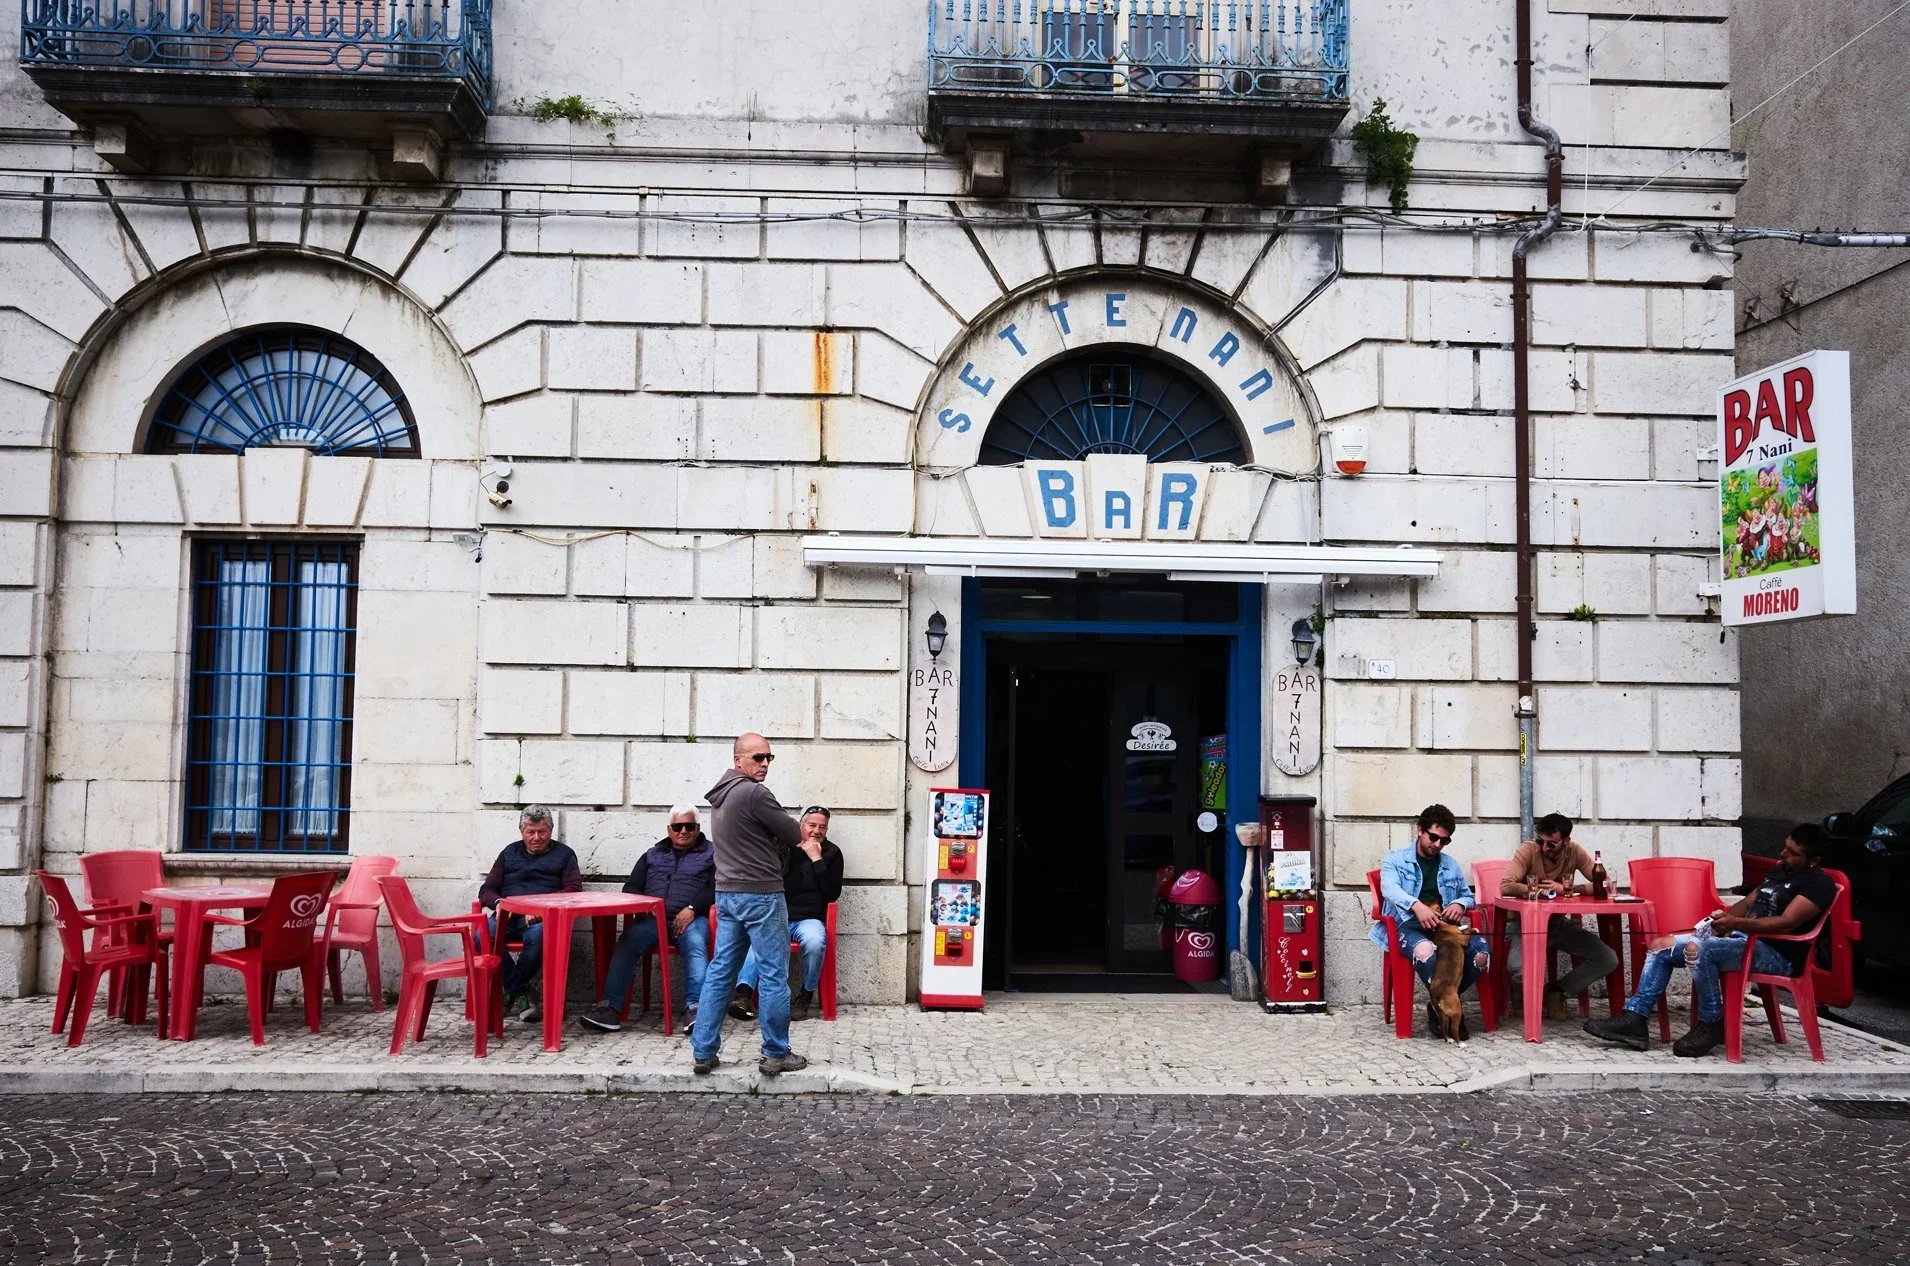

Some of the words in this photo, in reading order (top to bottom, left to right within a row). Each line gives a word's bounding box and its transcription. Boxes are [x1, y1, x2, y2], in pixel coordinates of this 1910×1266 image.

[938, 293, 1127, 433] SETTE
[1169, 307, 1296, 435] NANI
[1724, 366, 1816, 467] BAR
[1746, 449, 1754, 464] 7
[1759, 437, 1793, 461] Nani
[1037, 469, 1198, 531] BAR
[1743, 586, 1800, 618] MORENO
[915, 667, 954, 688] BAR
[1376, 663, 1390, 674] 40
[1278, 672, 1317, 693] BAR
[1133, 740, 1170, 750] Desirée
[283, 917, 316, 929] ALGIDA
[1187, 950, 1215, 958] ALGIDA
